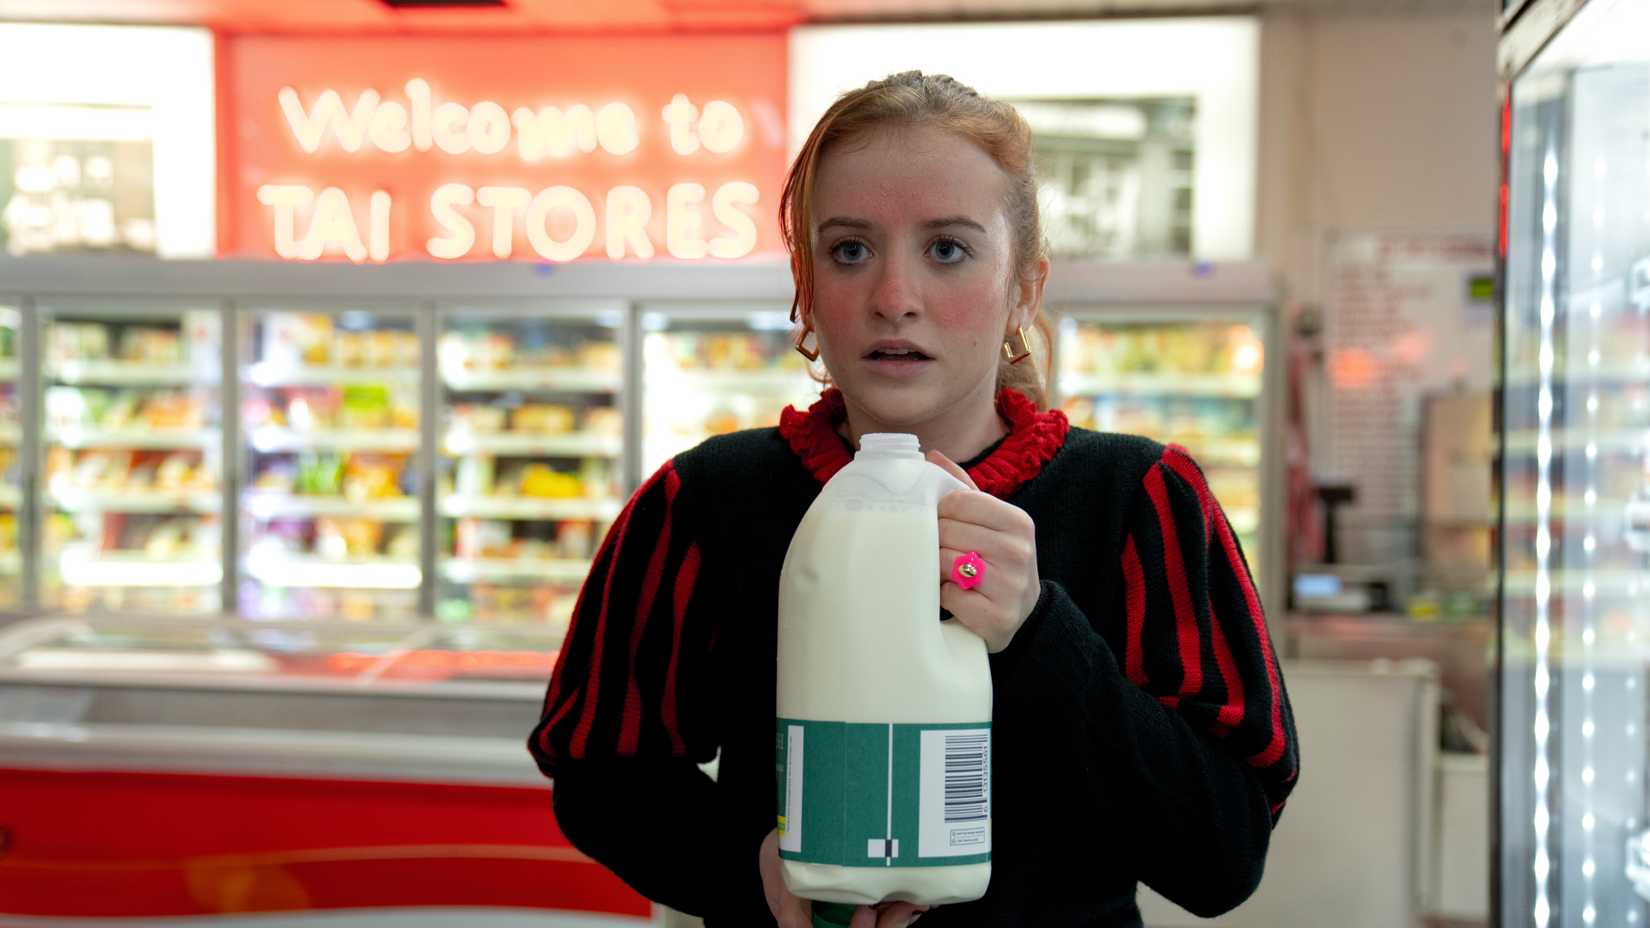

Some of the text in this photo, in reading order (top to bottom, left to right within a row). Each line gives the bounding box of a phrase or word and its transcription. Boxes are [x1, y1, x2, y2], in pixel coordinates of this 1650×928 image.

[278, 78, 744, 161] Welcome to
[257, 181, 760, 262] TAI STORES
